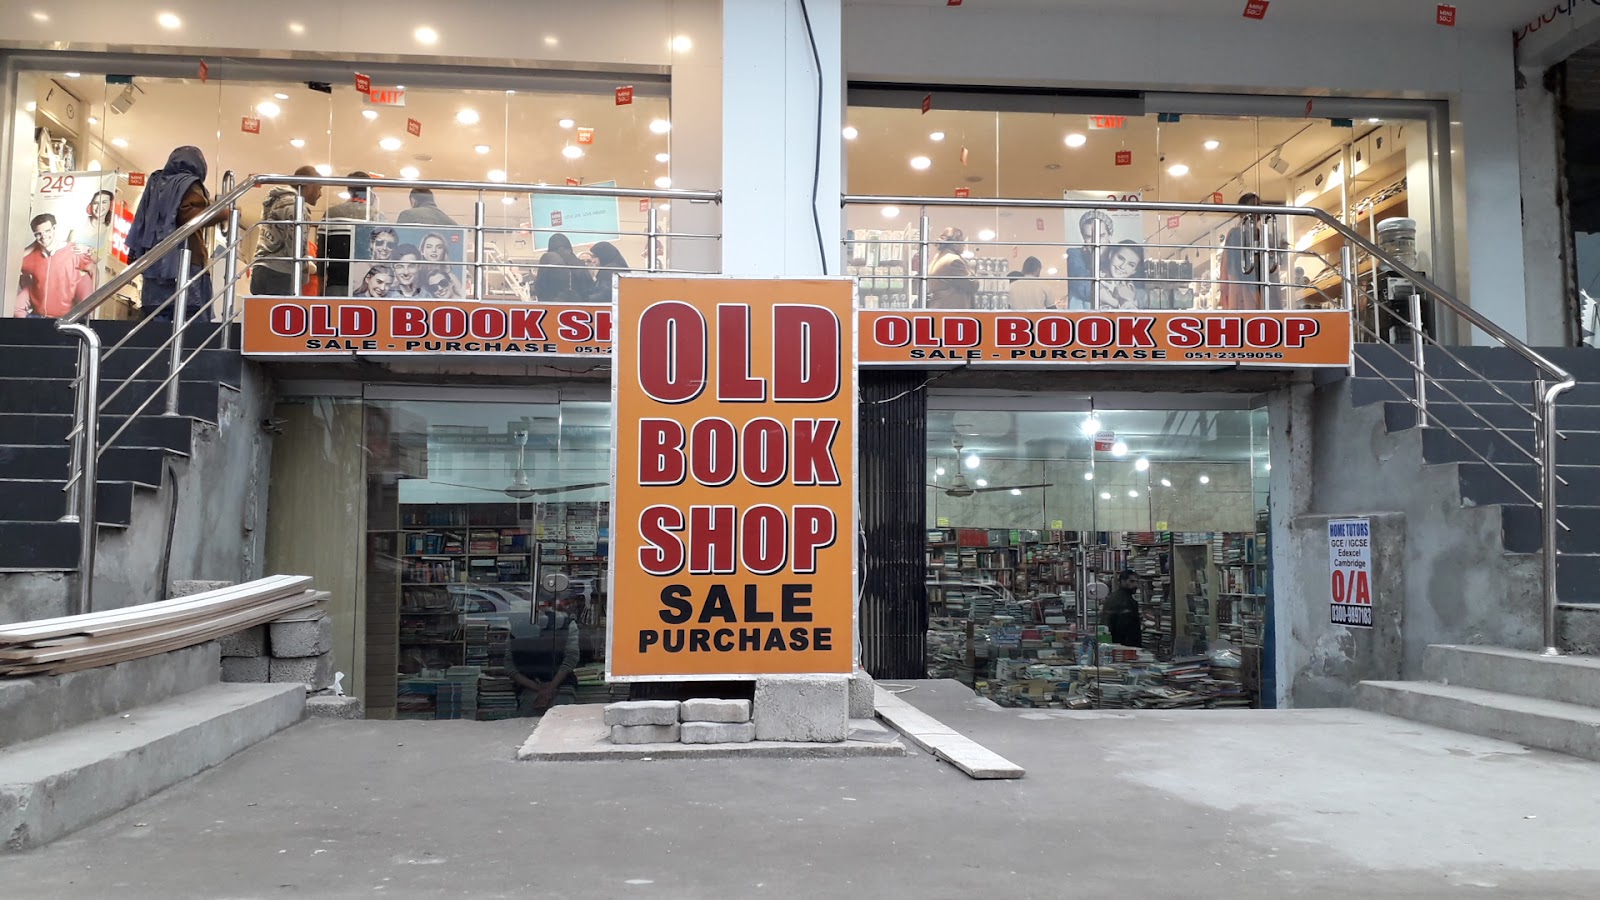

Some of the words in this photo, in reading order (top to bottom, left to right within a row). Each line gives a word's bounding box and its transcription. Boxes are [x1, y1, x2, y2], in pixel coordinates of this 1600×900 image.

[40, 176, 74, 193] 249
[270, 303, 377, 337] OLD
[390, 305, 548, 341] BOOK
[558, 310, 612, 342] SH
[874, 316, 982, 348] OLD
[994, 316, 1157, 348] BOOK
[1166, 316, 1320, 348] SHOP
[306, 339, 377, 350] SALE
[405, 341, 557, 353] PURCHASE
[637, 300, 841, 402] OLD
[909, 349, 982, 359] SALE
[1011, 349, 1167, 359] PURCHASE
[638, 416, 842, 486] BOOK
[638, 503, 837, 574] SHOP
[1330, 524, 1345, 537] HOME
[1346, 523, 1368, 536] TUTORS
[1338, 549, 1361, 557] Edexcel
[1349, 539, 1368, 547] IGCSE
[1334, 559, 1366, 568] Cambridge
[1332, 570, 1370, 604] O/A
[659, 584, 814, 624] SALE
[638, 627, 832, 652] PURCHASE
